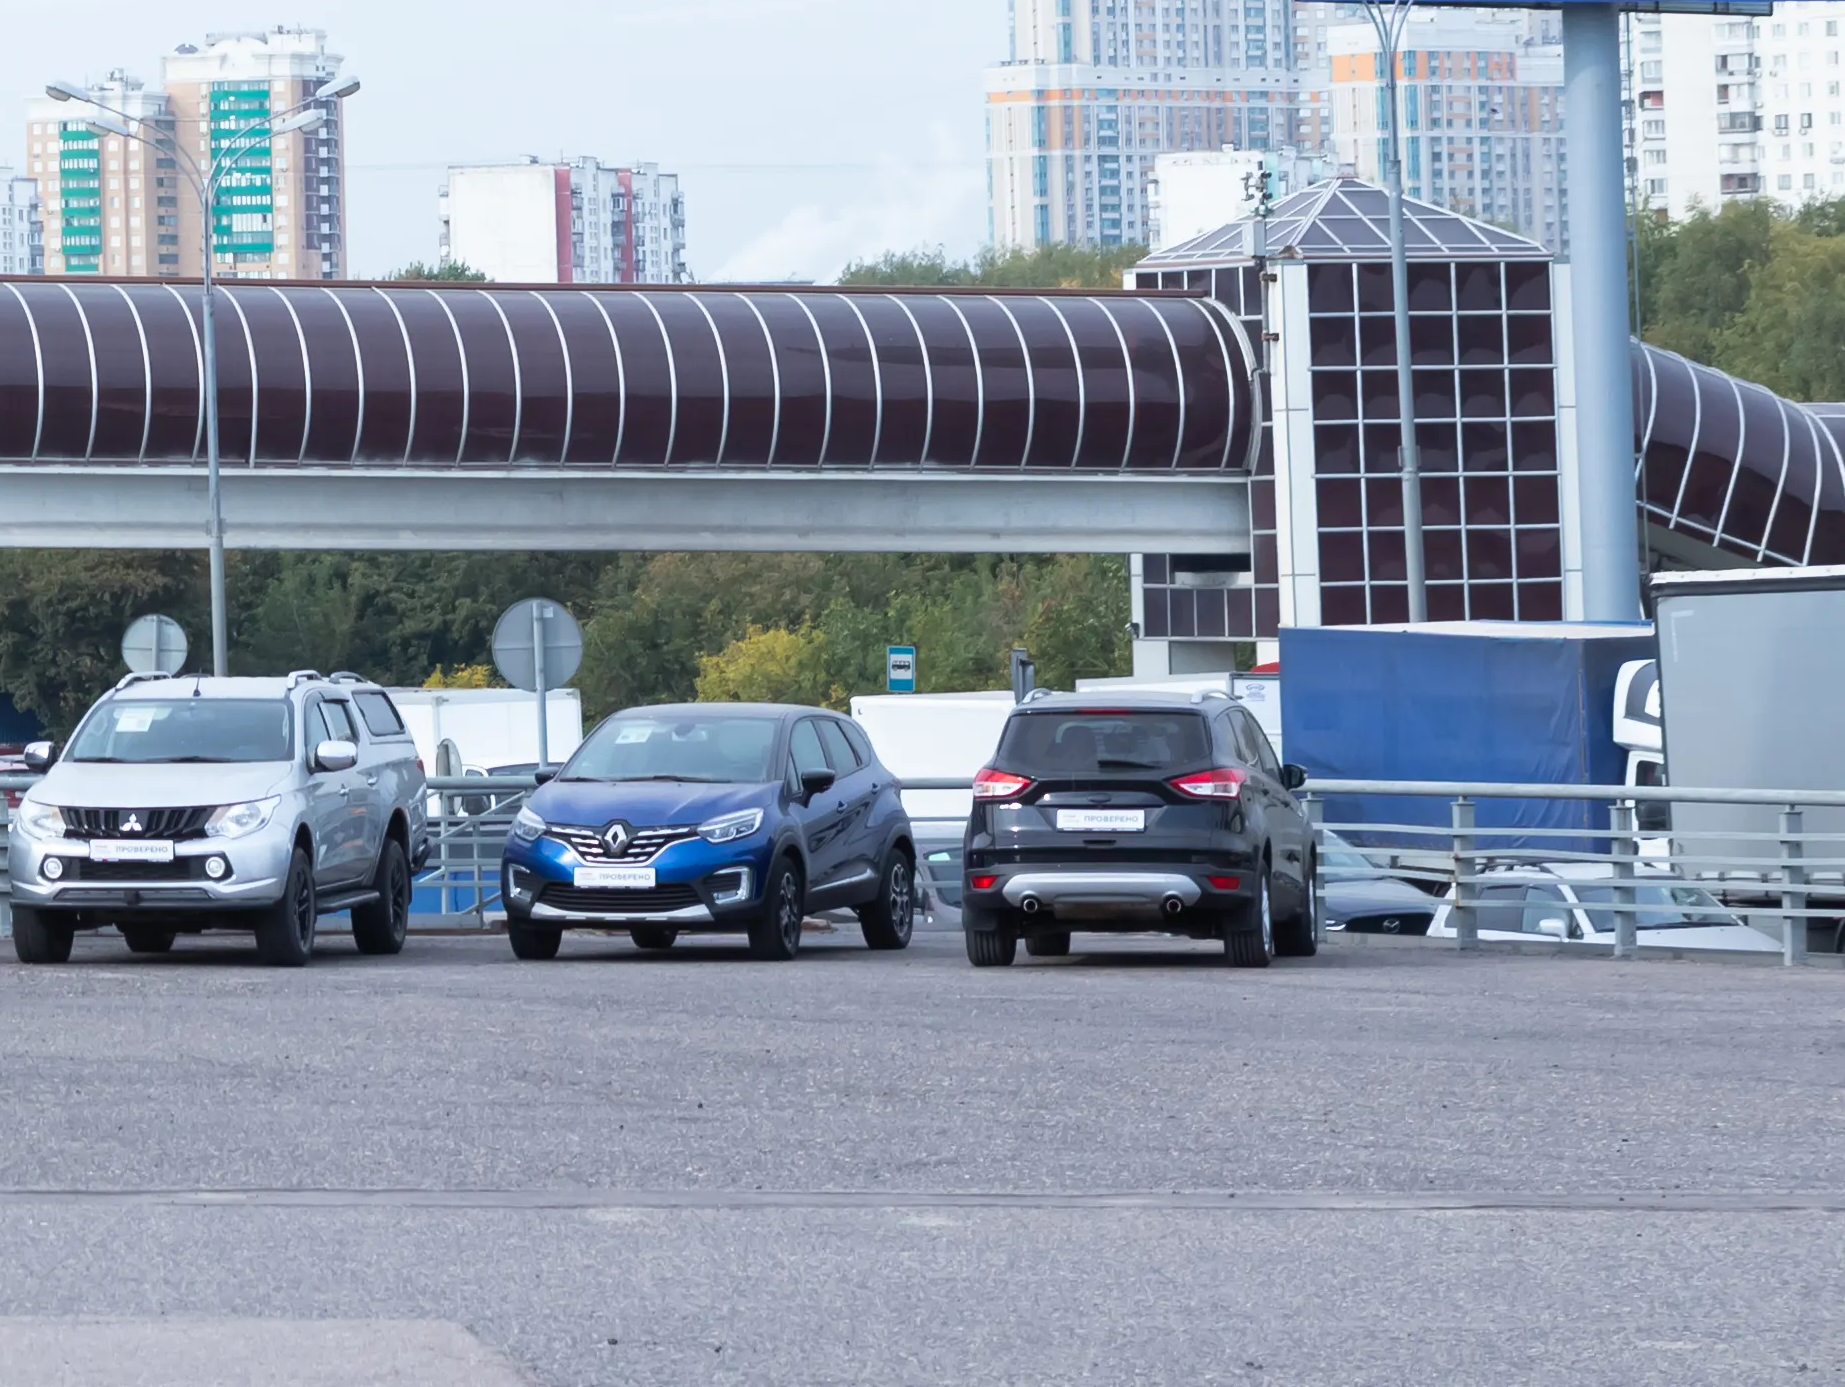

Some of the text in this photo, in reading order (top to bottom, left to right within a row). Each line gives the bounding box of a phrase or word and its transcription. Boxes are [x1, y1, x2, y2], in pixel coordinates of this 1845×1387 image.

[1084, 815, 1138, 823] ПРОВЕРЕНО
[116, 845, 168, 853] ПРОВЕРЕНО
[599, 873, 651, 881] ПРОВЕРЕНО
